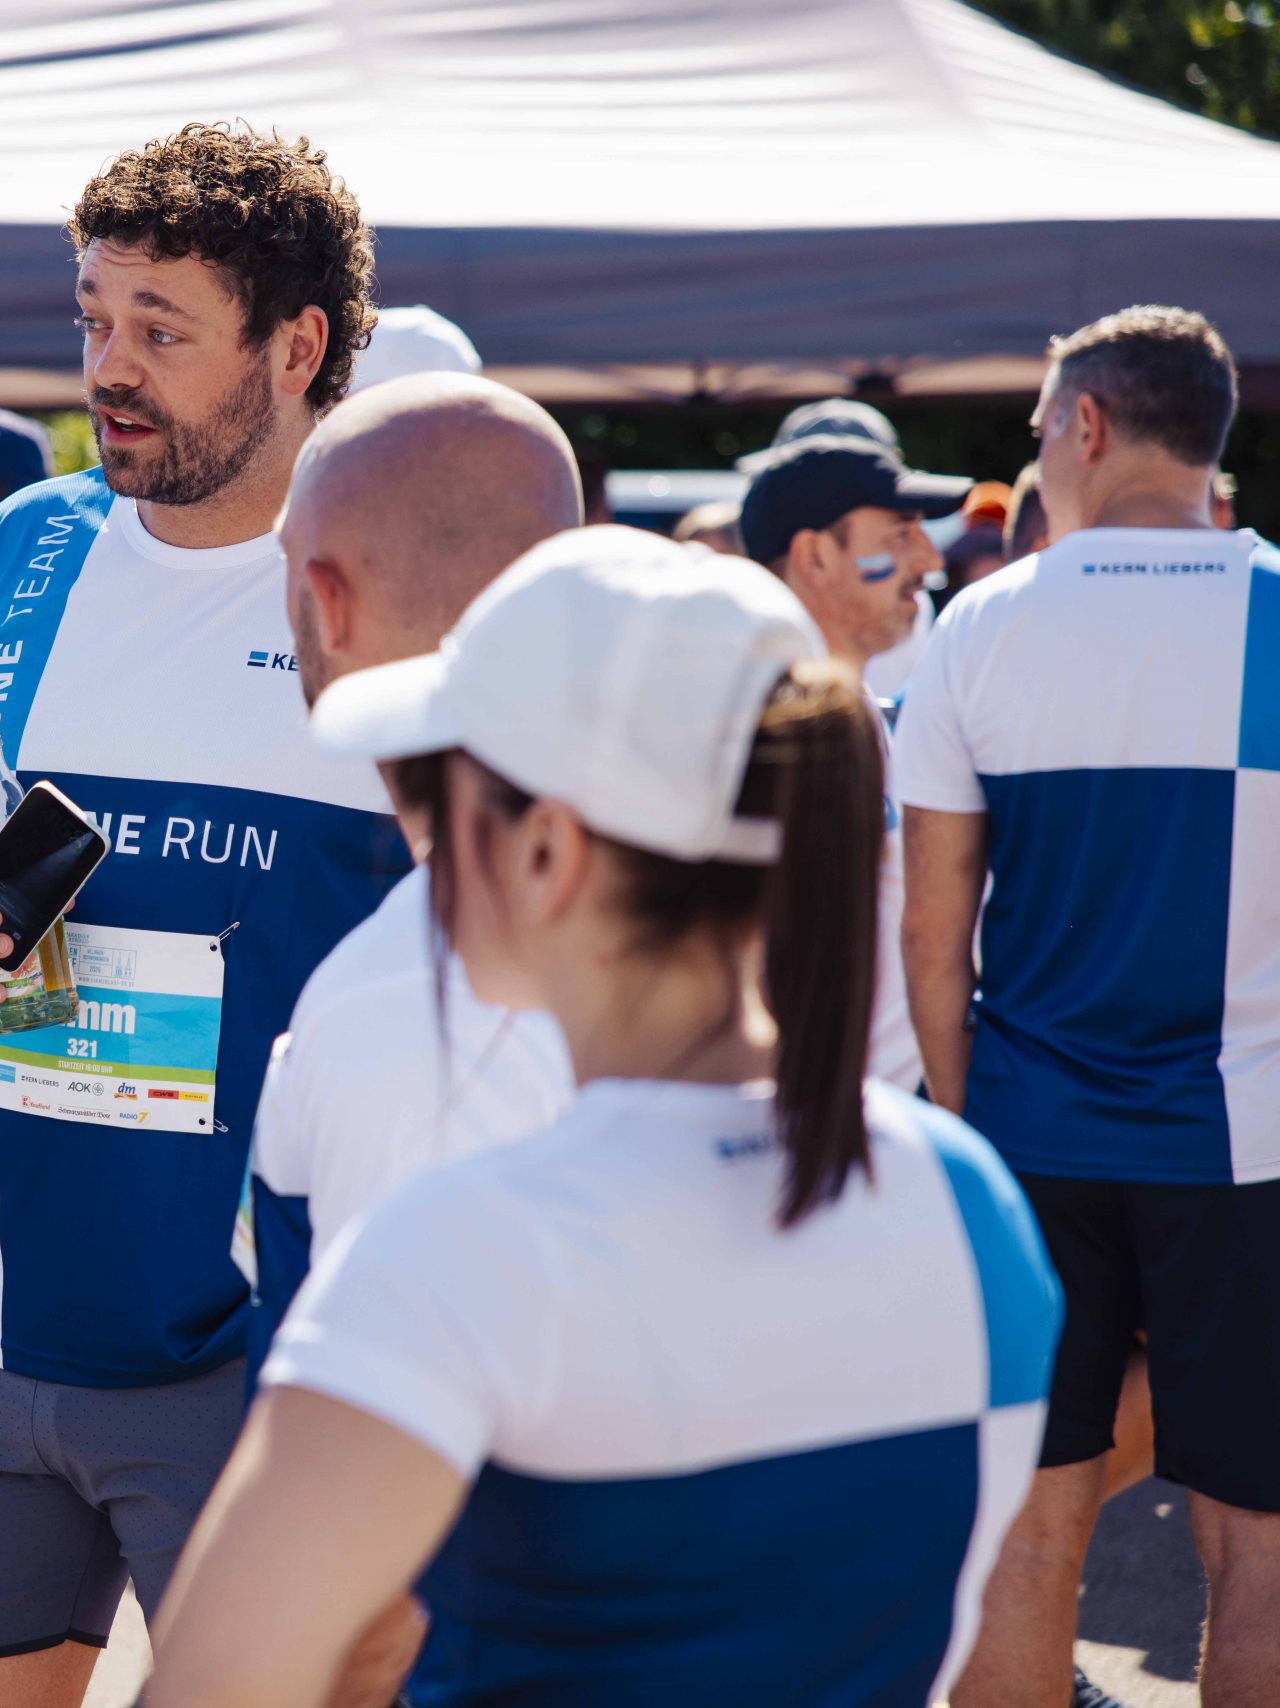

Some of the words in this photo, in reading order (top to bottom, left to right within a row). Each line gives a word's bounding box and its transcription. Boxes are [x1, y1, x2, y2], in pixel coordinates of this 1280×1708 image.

[1, 514, 81, 627] TEAM
[1100, 562, 1147, 574] KERN
[1152, 562, 1227, 574] LIEBERS
[272, 653, 299, 671] KE
[161, 816, 278, 871] RUN
[66, 1037, 98, 1058] 321
[39, 1078, 59, 1087] LIEBERS
[67, 1081, 91, 1093] AOK
[117, 1082, 136, 1095] dm
[120, 1112, 138, 1120] RADIO
[138, 1111, 149, 1123] 7
